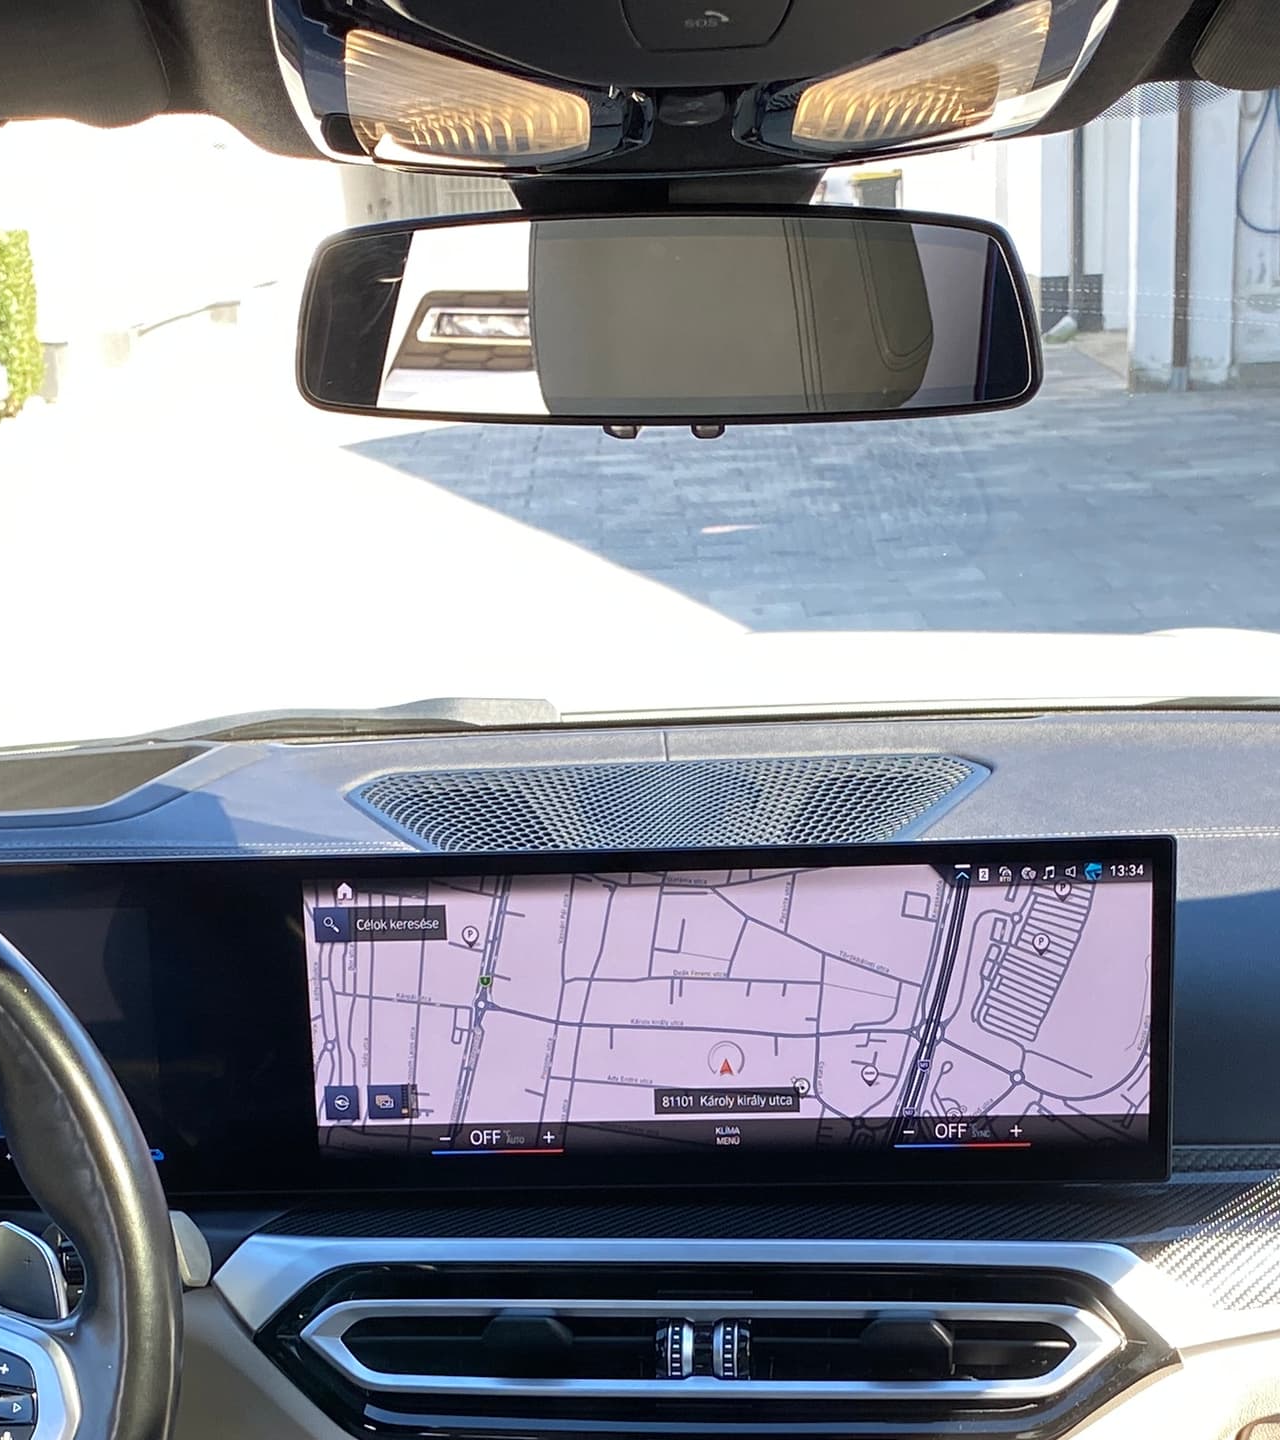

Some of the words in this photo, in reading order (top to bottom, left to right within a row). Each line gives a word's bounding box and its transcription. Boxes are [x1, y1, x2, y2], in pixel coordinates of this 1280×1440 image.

[1109, 864, 1144, 877] 13:34
[356, 917, 387, 931] Célok
[389, 917, 440, 931] keresése
[662, 1096, 694, 1107] 81101
[700, 1095, 735, 1109] Károly
[737, 1095, 766, 1108] király
[768, 1096, 793, 1106] utca
[470, 1129, 501, 1145] OFF
[935, 1123, 967, 1139] OFF
